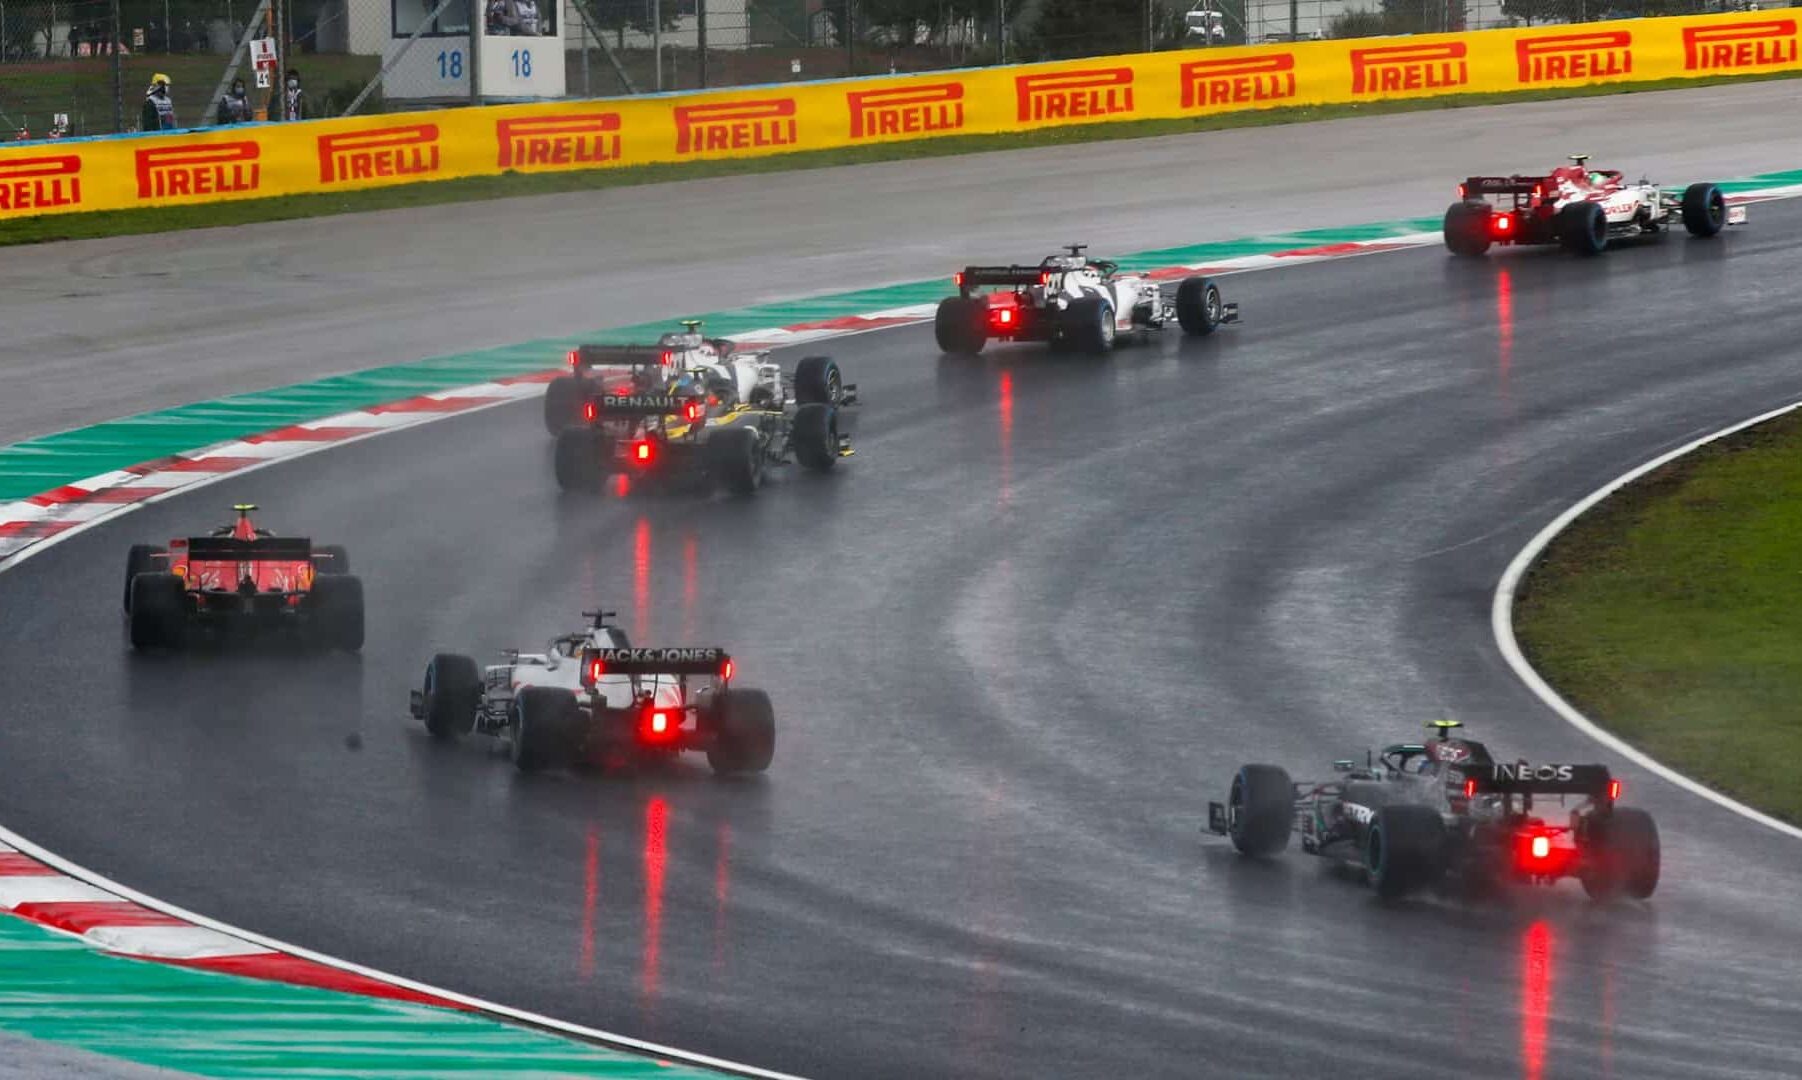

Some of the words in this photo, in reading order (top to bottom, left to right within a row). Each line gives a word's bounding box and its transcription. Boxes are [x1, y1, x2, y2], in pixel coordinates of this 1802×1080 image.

[437, 51, 463, 78] 18
[512, 50, 531, 77] 18
[1350, 42, 1467, 94] PIRELLI
[1515, 31, 1632, 82] PIRELLI
[1682, 19, 1797, 70] PIRELLI
[1016, 67, 1134, 121] PIRELLI
[1181, 53, 1296, 107] PIRELLI
[674, 98, 796, 153] PIRELLI
[847, 82, 964, 138] PIRELLI
[317, 123, 439, 184] PIRELLI
[497, 113, 620, 168] PIRELLI
[0, 154, 82, 210] RELLI
[135, 140, 260, 199] PIRELLI
[603, 396, 689, 408] RENAULT
[1493, 764, 1573, 782] INEOS
